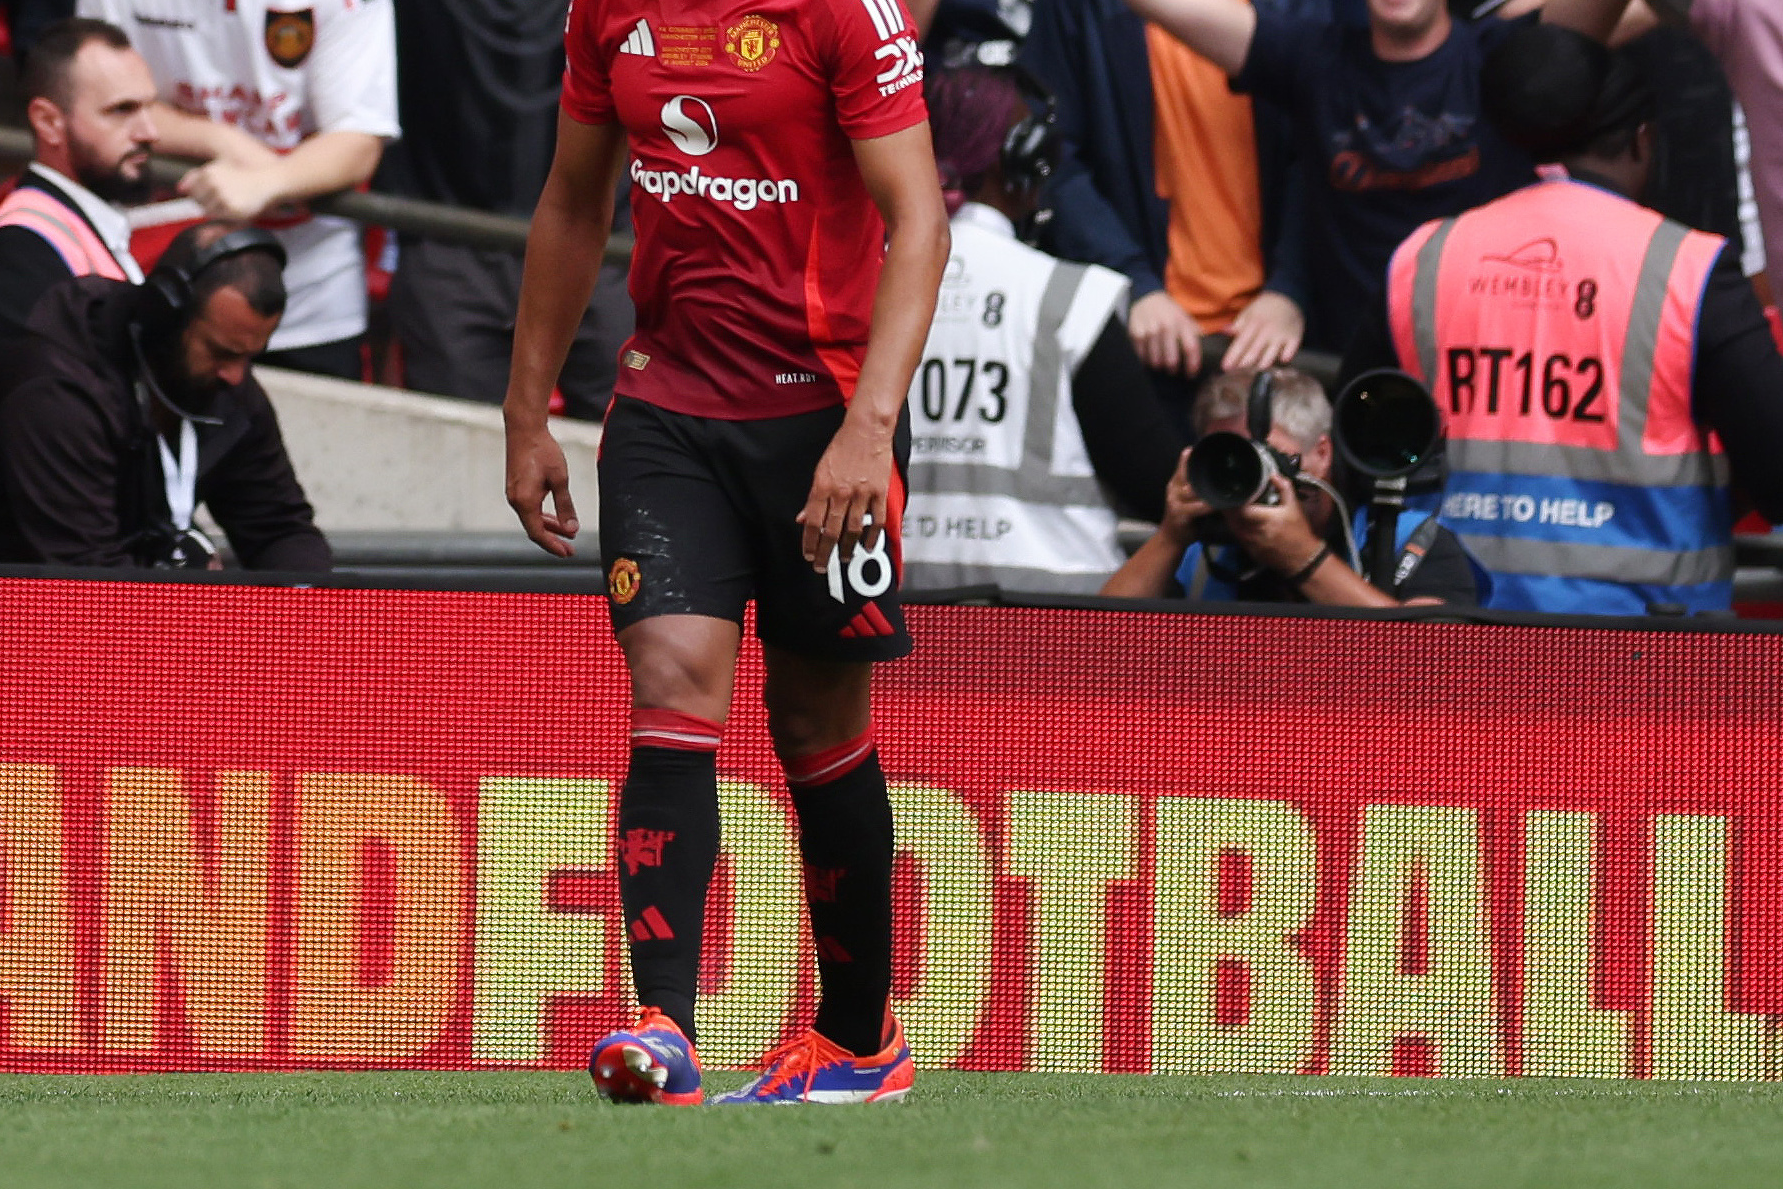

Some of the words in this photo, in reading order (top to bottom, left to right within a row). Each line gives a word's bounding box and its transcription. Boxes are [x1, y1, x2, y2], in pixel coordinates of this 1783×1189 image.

[629, 158, 799, 211] Snapdragon
[982, 292, 1006, 328] 8
[1574, 278, 1598, 320] 8
[1446, 346, 1606, 424] RT162
[945, 516, 1013, 541] HELP
[1501, 494, 1535, 523] TO
[1538, 497, 1617, 530] HELP
